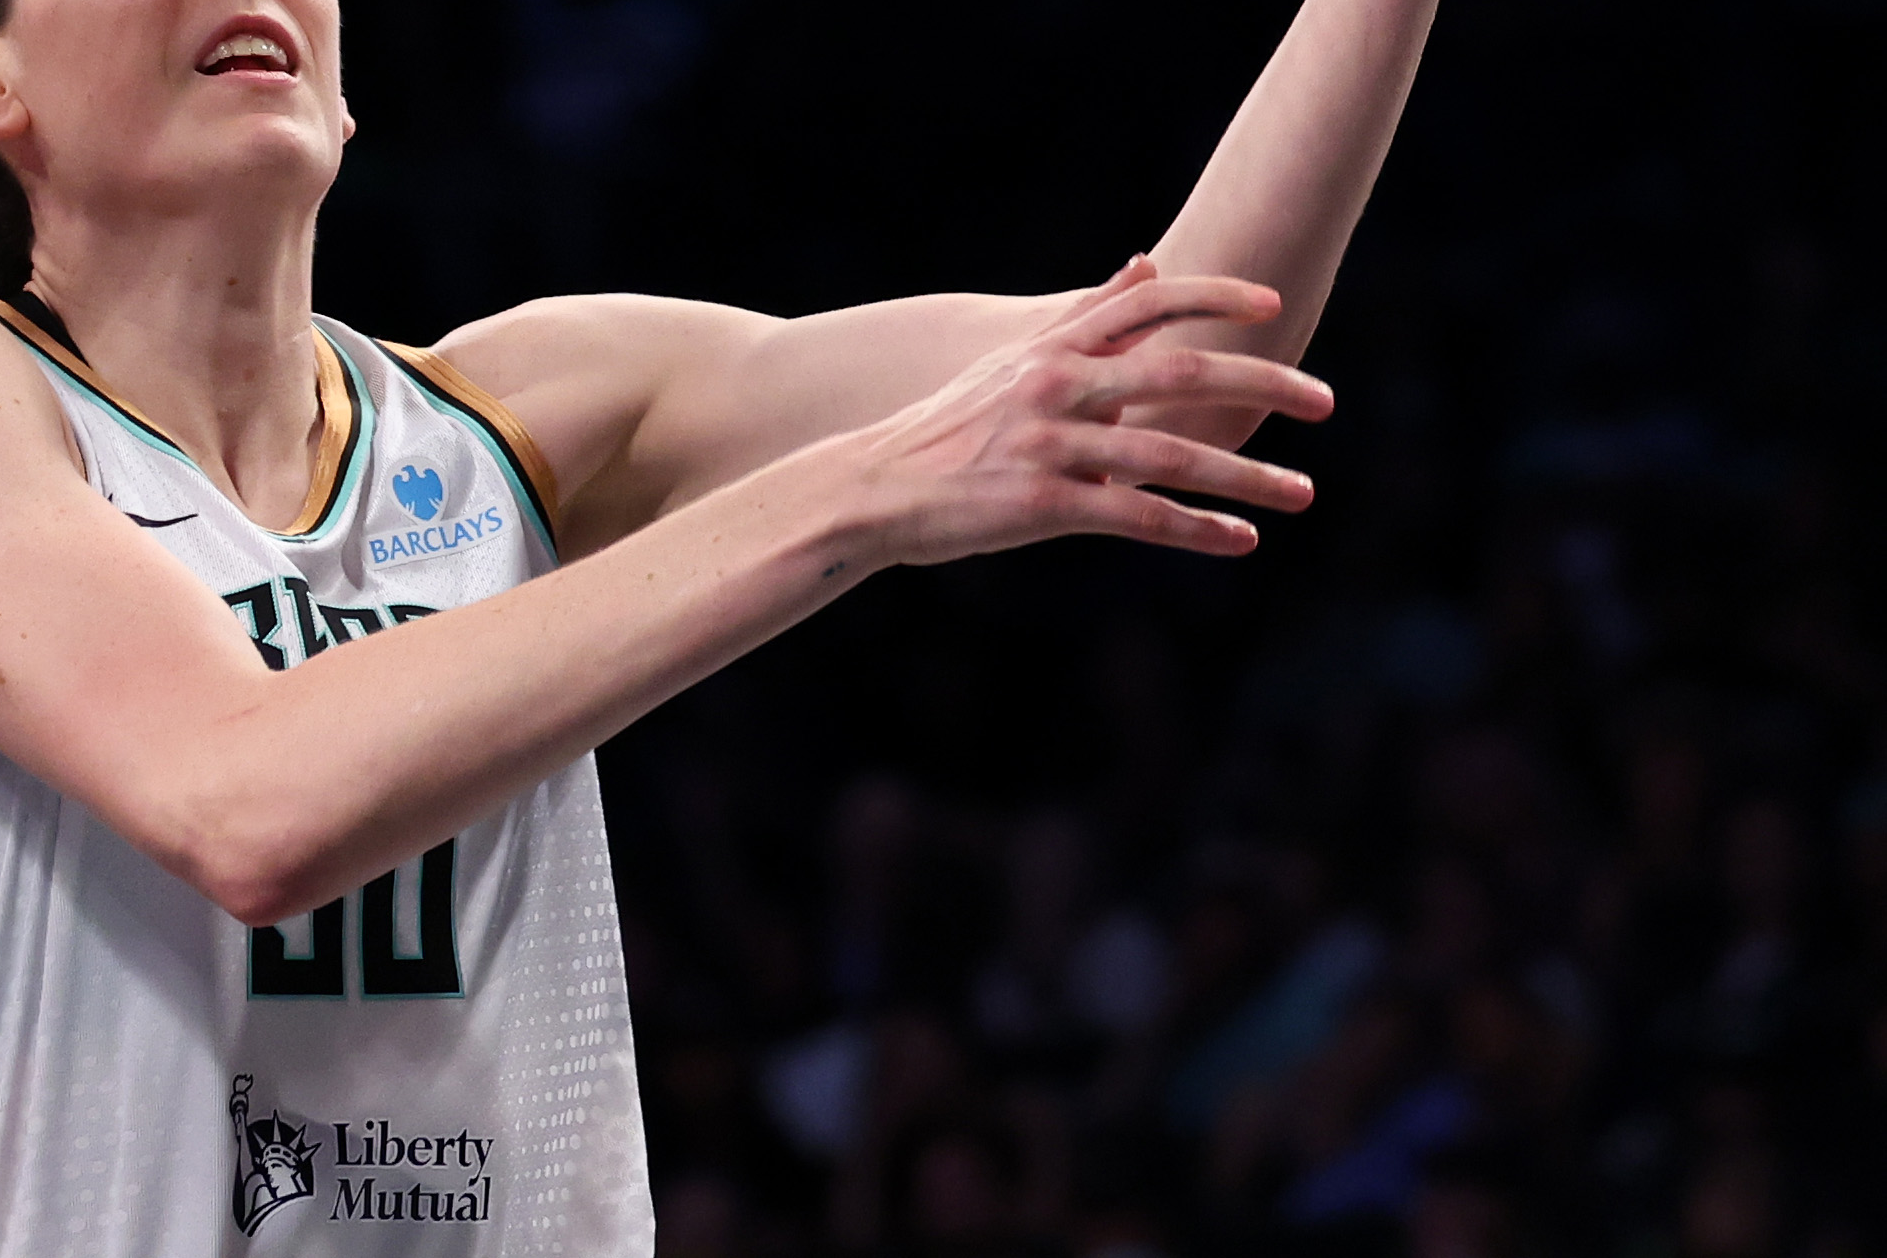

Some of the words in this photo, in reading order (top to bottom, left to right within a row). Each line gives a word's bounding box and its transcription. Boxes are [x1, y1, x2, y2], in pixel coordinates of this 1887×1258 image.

[369, 506, 503, 564] BARCLAYS
[332, 1120, 494, 1187] Liberty
[330, 1177, 492, 1222] Mutual
